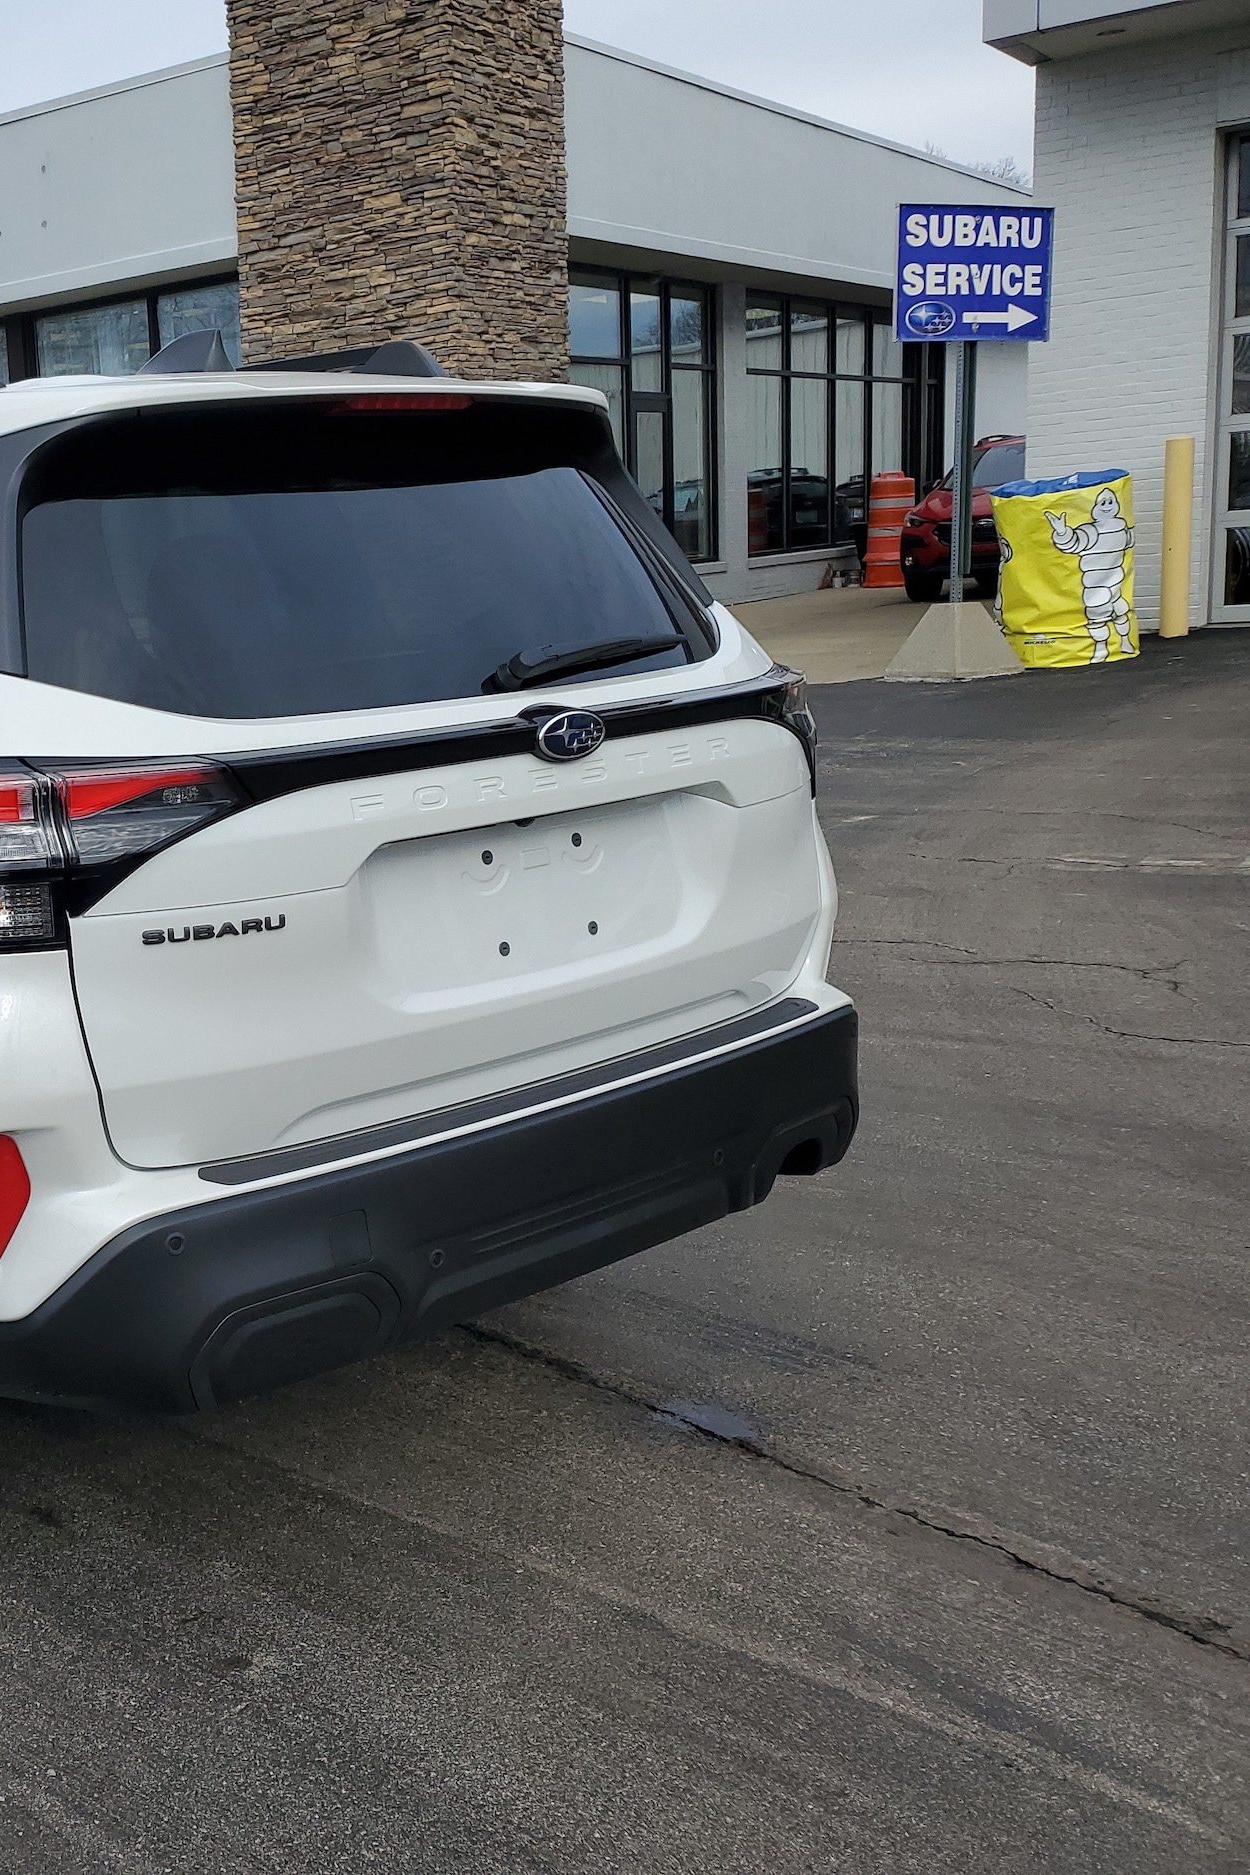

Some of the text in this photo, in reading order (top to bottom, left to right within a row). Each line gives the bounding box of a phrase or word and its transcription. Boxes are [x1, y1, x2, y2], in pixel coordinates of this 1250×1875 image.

[905, 213, 1043, 248] SUBARU
[902, 263, 1043, 296] SERVICE
[350, 737, 731, 822] FORESTER
[141, 913, 286, 946] SUBARU
